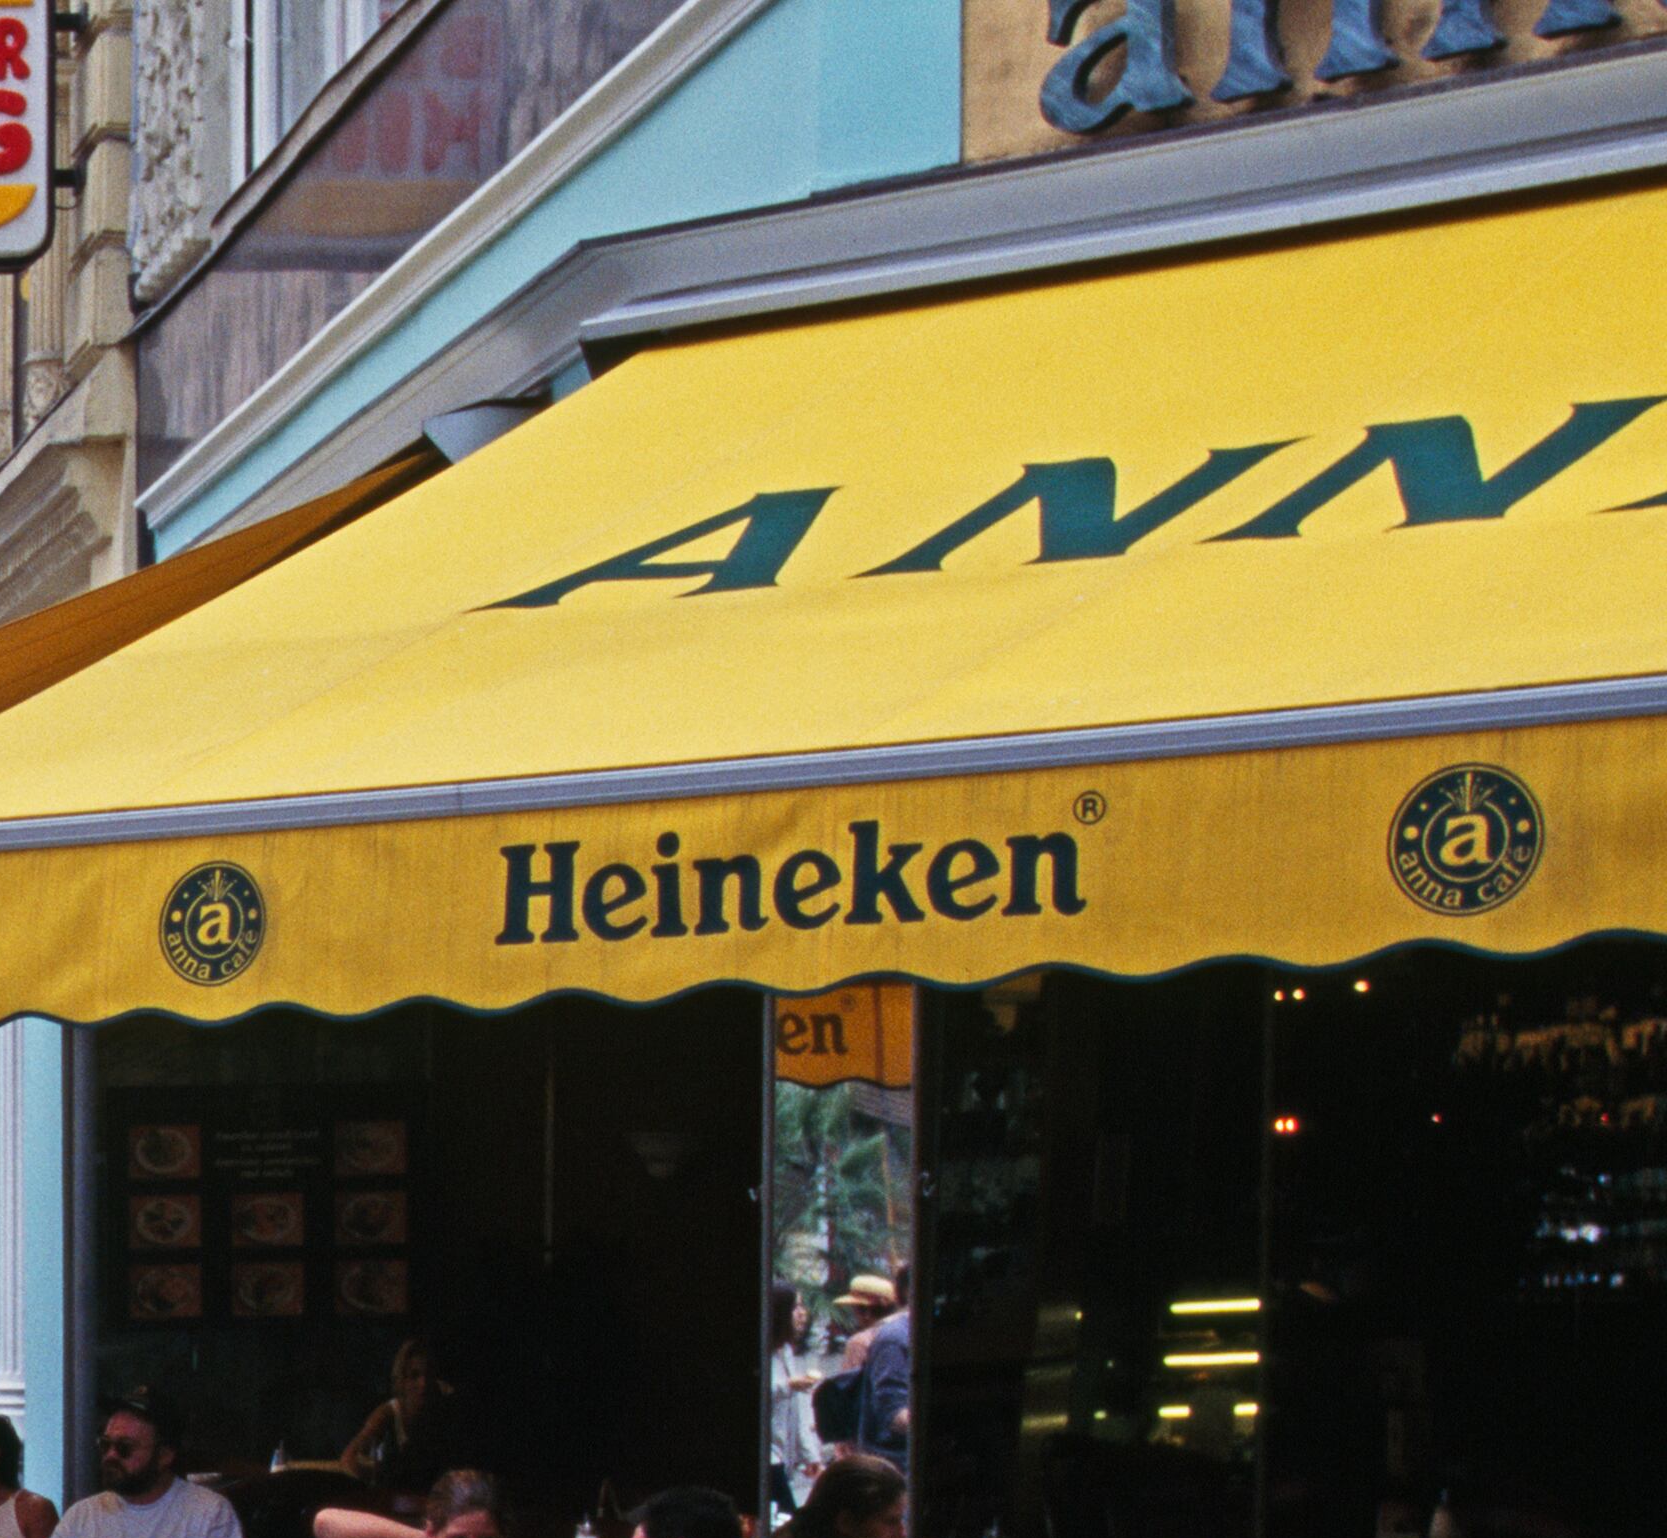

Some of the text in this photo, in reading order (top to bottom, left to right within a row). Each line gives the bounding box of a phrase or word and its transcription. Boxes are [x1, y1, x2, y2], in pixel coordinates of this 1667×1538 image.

[467, 395, 1667, 612] ANN
[1399, 851, 1461, 907] anna
[167, 932, 211, 979] anna
